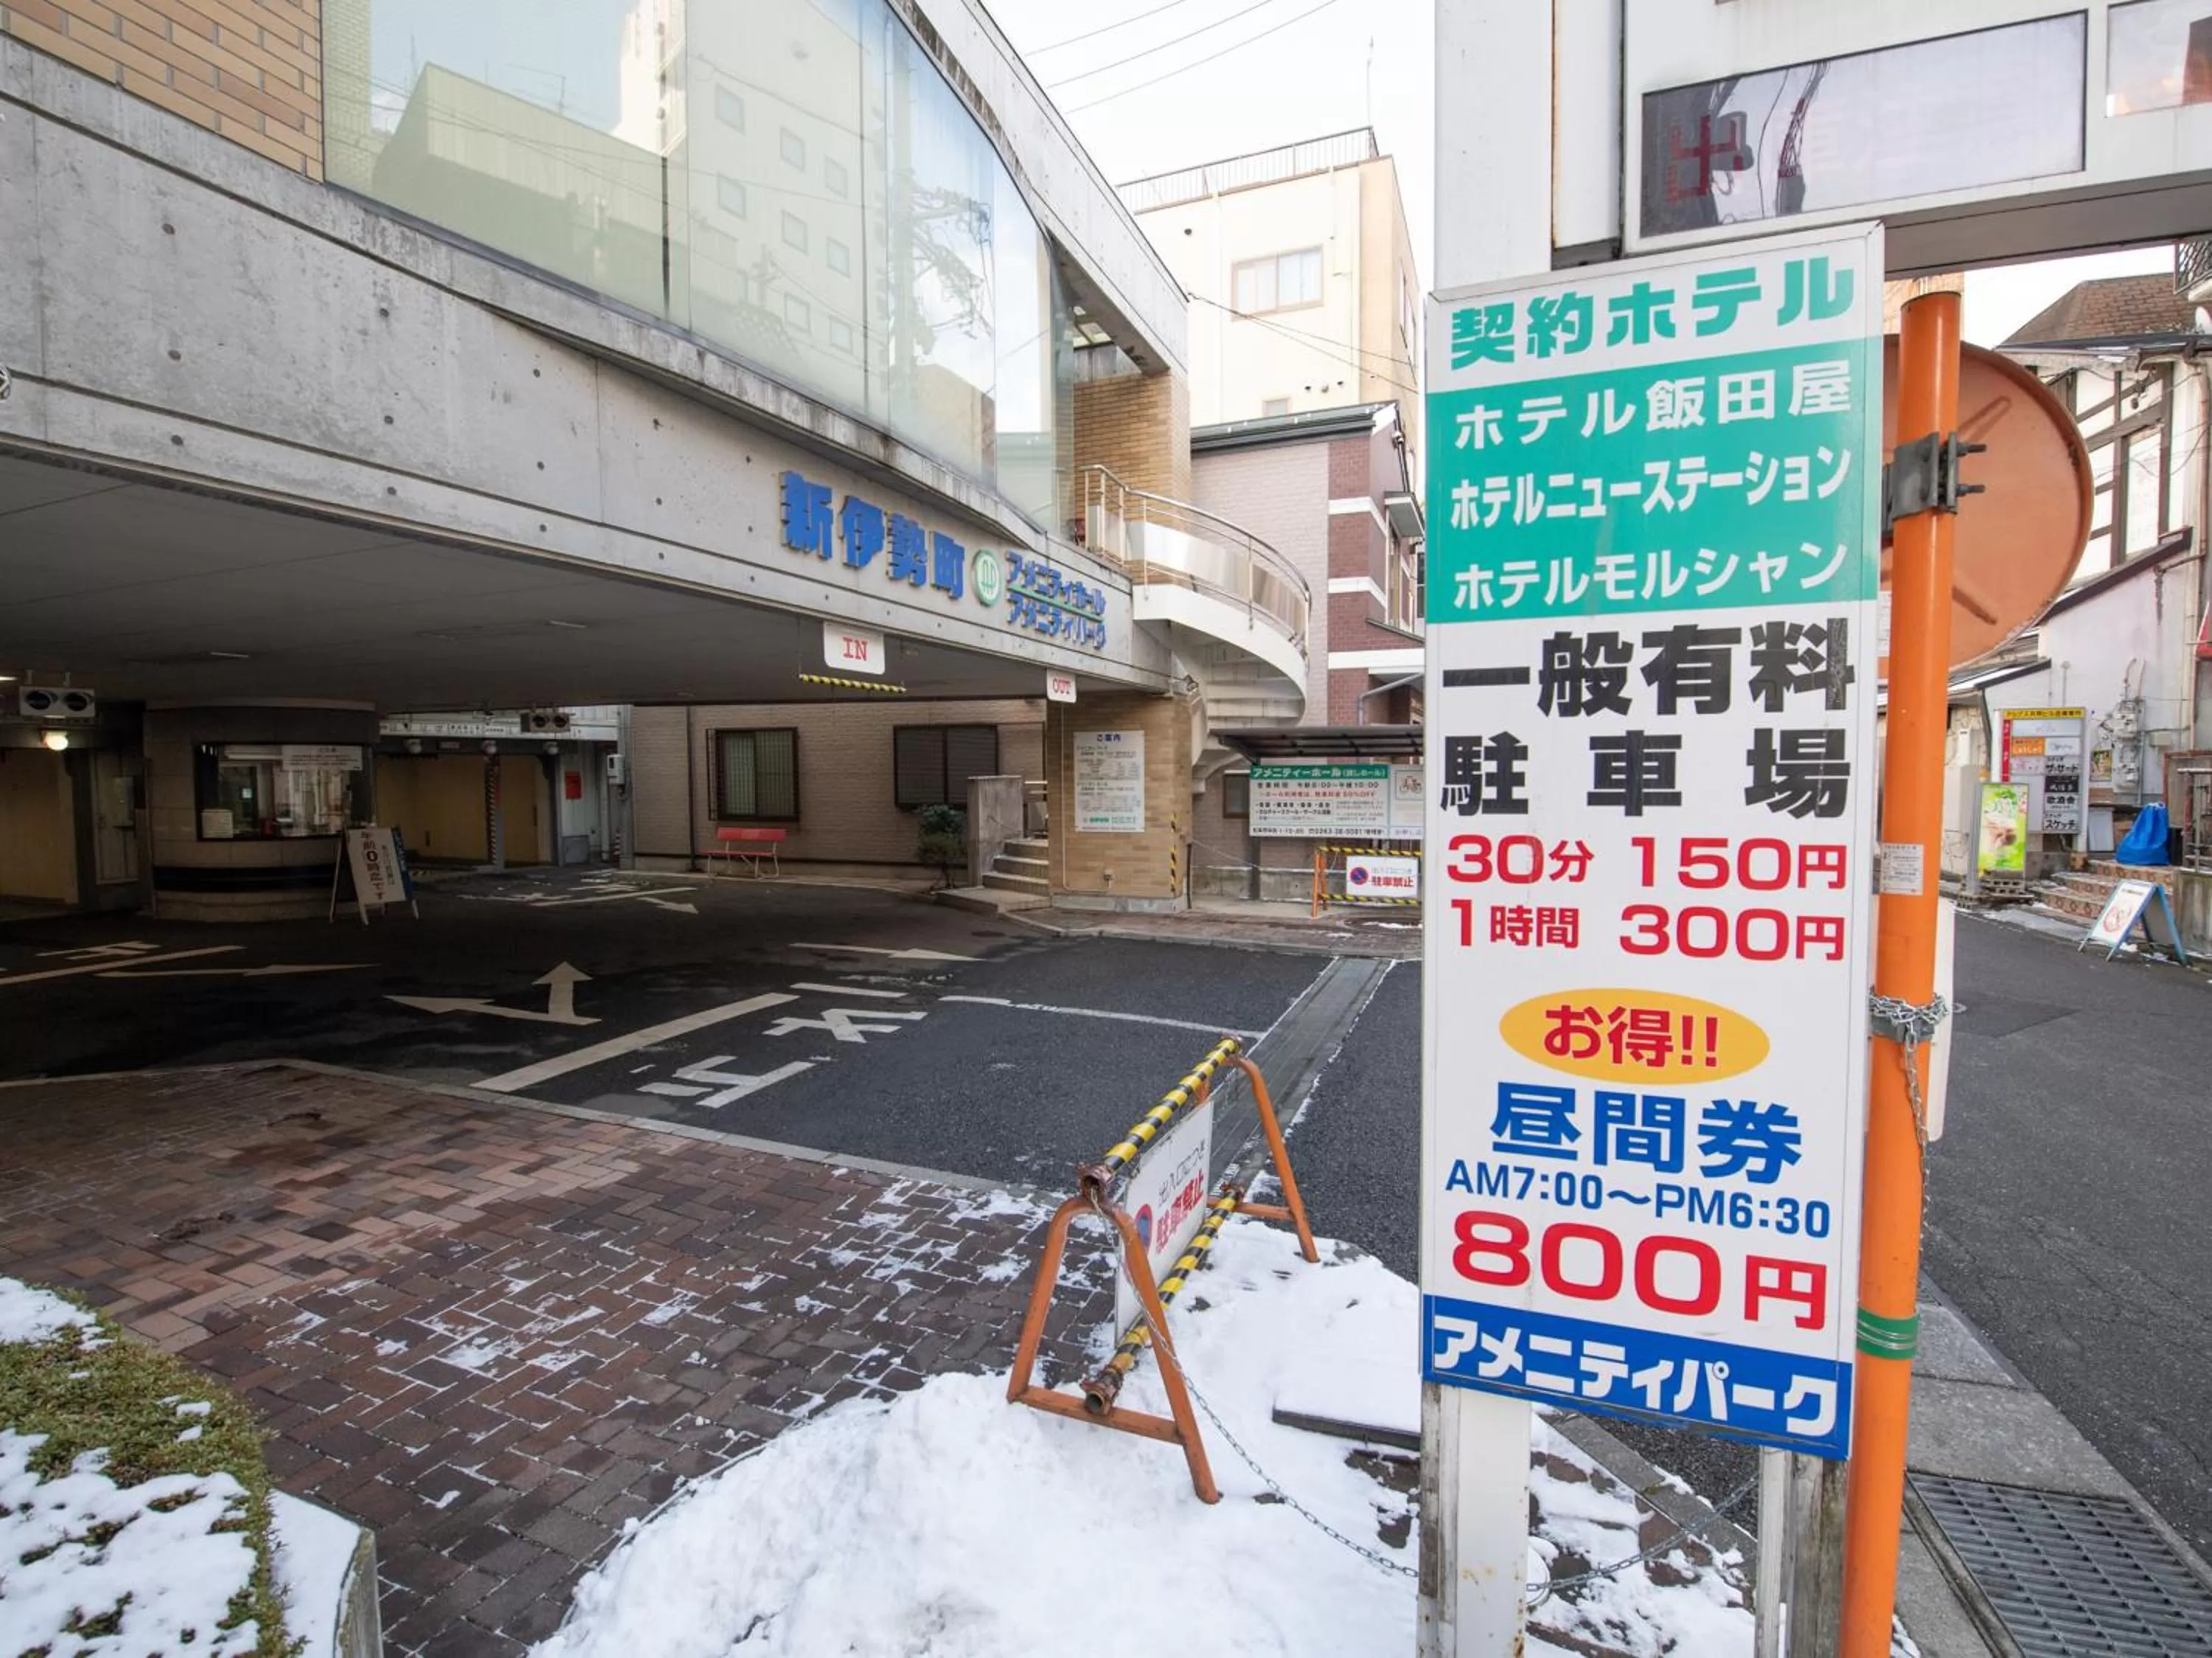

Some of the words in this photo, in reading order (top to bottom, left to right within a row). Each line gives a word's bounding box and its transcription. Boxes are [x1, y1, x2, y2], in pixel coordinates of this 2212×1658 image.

[1451, 257, 1854, 371] 契約ホテル
[1455, 359, 1851, 449] ホテル飯田屋
[1450, 445, 1851, 531] ホテルニューステーション
[1454, 542, 1848, 610] ホテルモルシャン
[843, 637, 868, 662] IN
[1053, 678, 1071, 695] OUT
[1443, 617, 1855, 718] 一般有料
[1440, 728, 1851, 819] 駐車場
[1371, 875, 1413, 888] 駐車禁止
[1447, 834, 1594, 884] 30分
[1632, 836, 1847, 891] 150円
[1451, 899, 1579, 949] 1時間
[1620, 904, 1845, 960] 300円
[1545, 1005, 1718, 1067] お得!!
[1490, 1082, 1801, 1184] 昼間券
[1453, 1210, 1827, 1331] 800円
[1434, 1315, 1837, 1437] アメニティパーク
